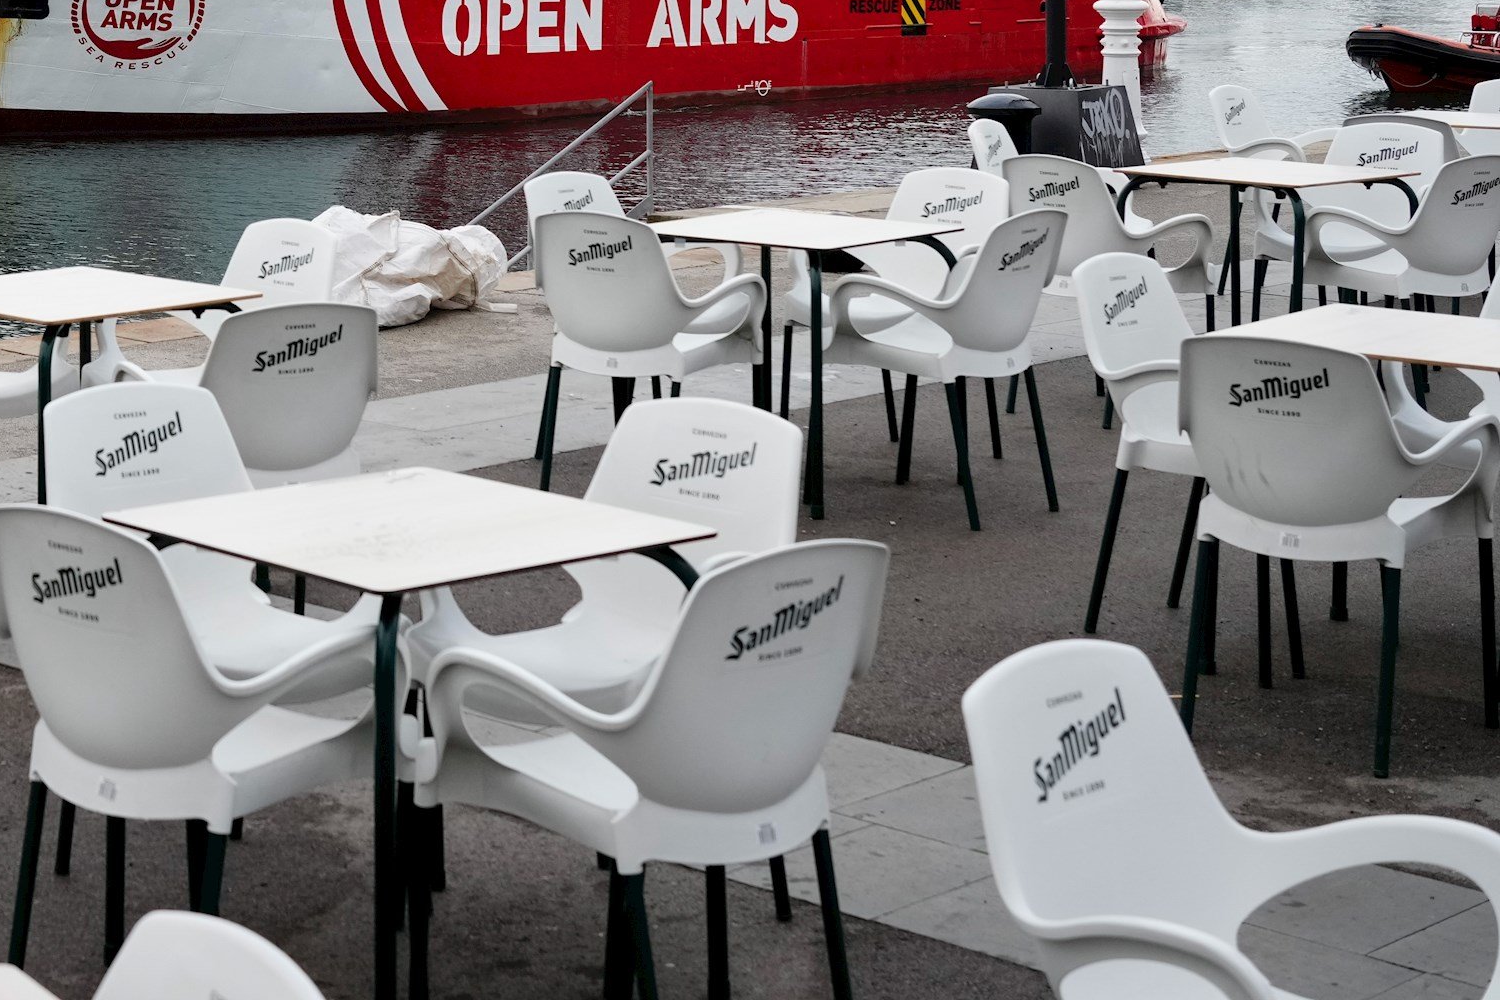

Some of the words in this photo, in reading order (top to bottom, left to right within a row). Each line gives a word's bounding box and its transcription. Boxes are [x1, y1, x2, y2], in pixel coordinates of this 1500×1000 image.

[100, 9, 174, 32] ARMS
[78, 37, 105, 63] SEA
[114, 41, 188, 70] RESCUE
[1356, 141, 1419, 167] SanMiguel
[563, 189, 594, 211] Miguel
[920, 190, 984, 218] SanMiguel
[1029, 176, 1080, 202] SanMiguel
[1451, 177, 1500, 205] SanMigue
[568, 235, 633, 266] SanMiguel
[252, 323, 343, 372] SanMiguel
[1228, 368, 1329, 407] SanMiguel
[95, 411, 183, 476] SanMiguel
[648, 441, 758, 487] SanMiguel
[32, 556, 123, 604] SanMiguel
[725, 574, 846, 661] SanMiguel
[1033, 686, 1127, 803] SanMiguel
